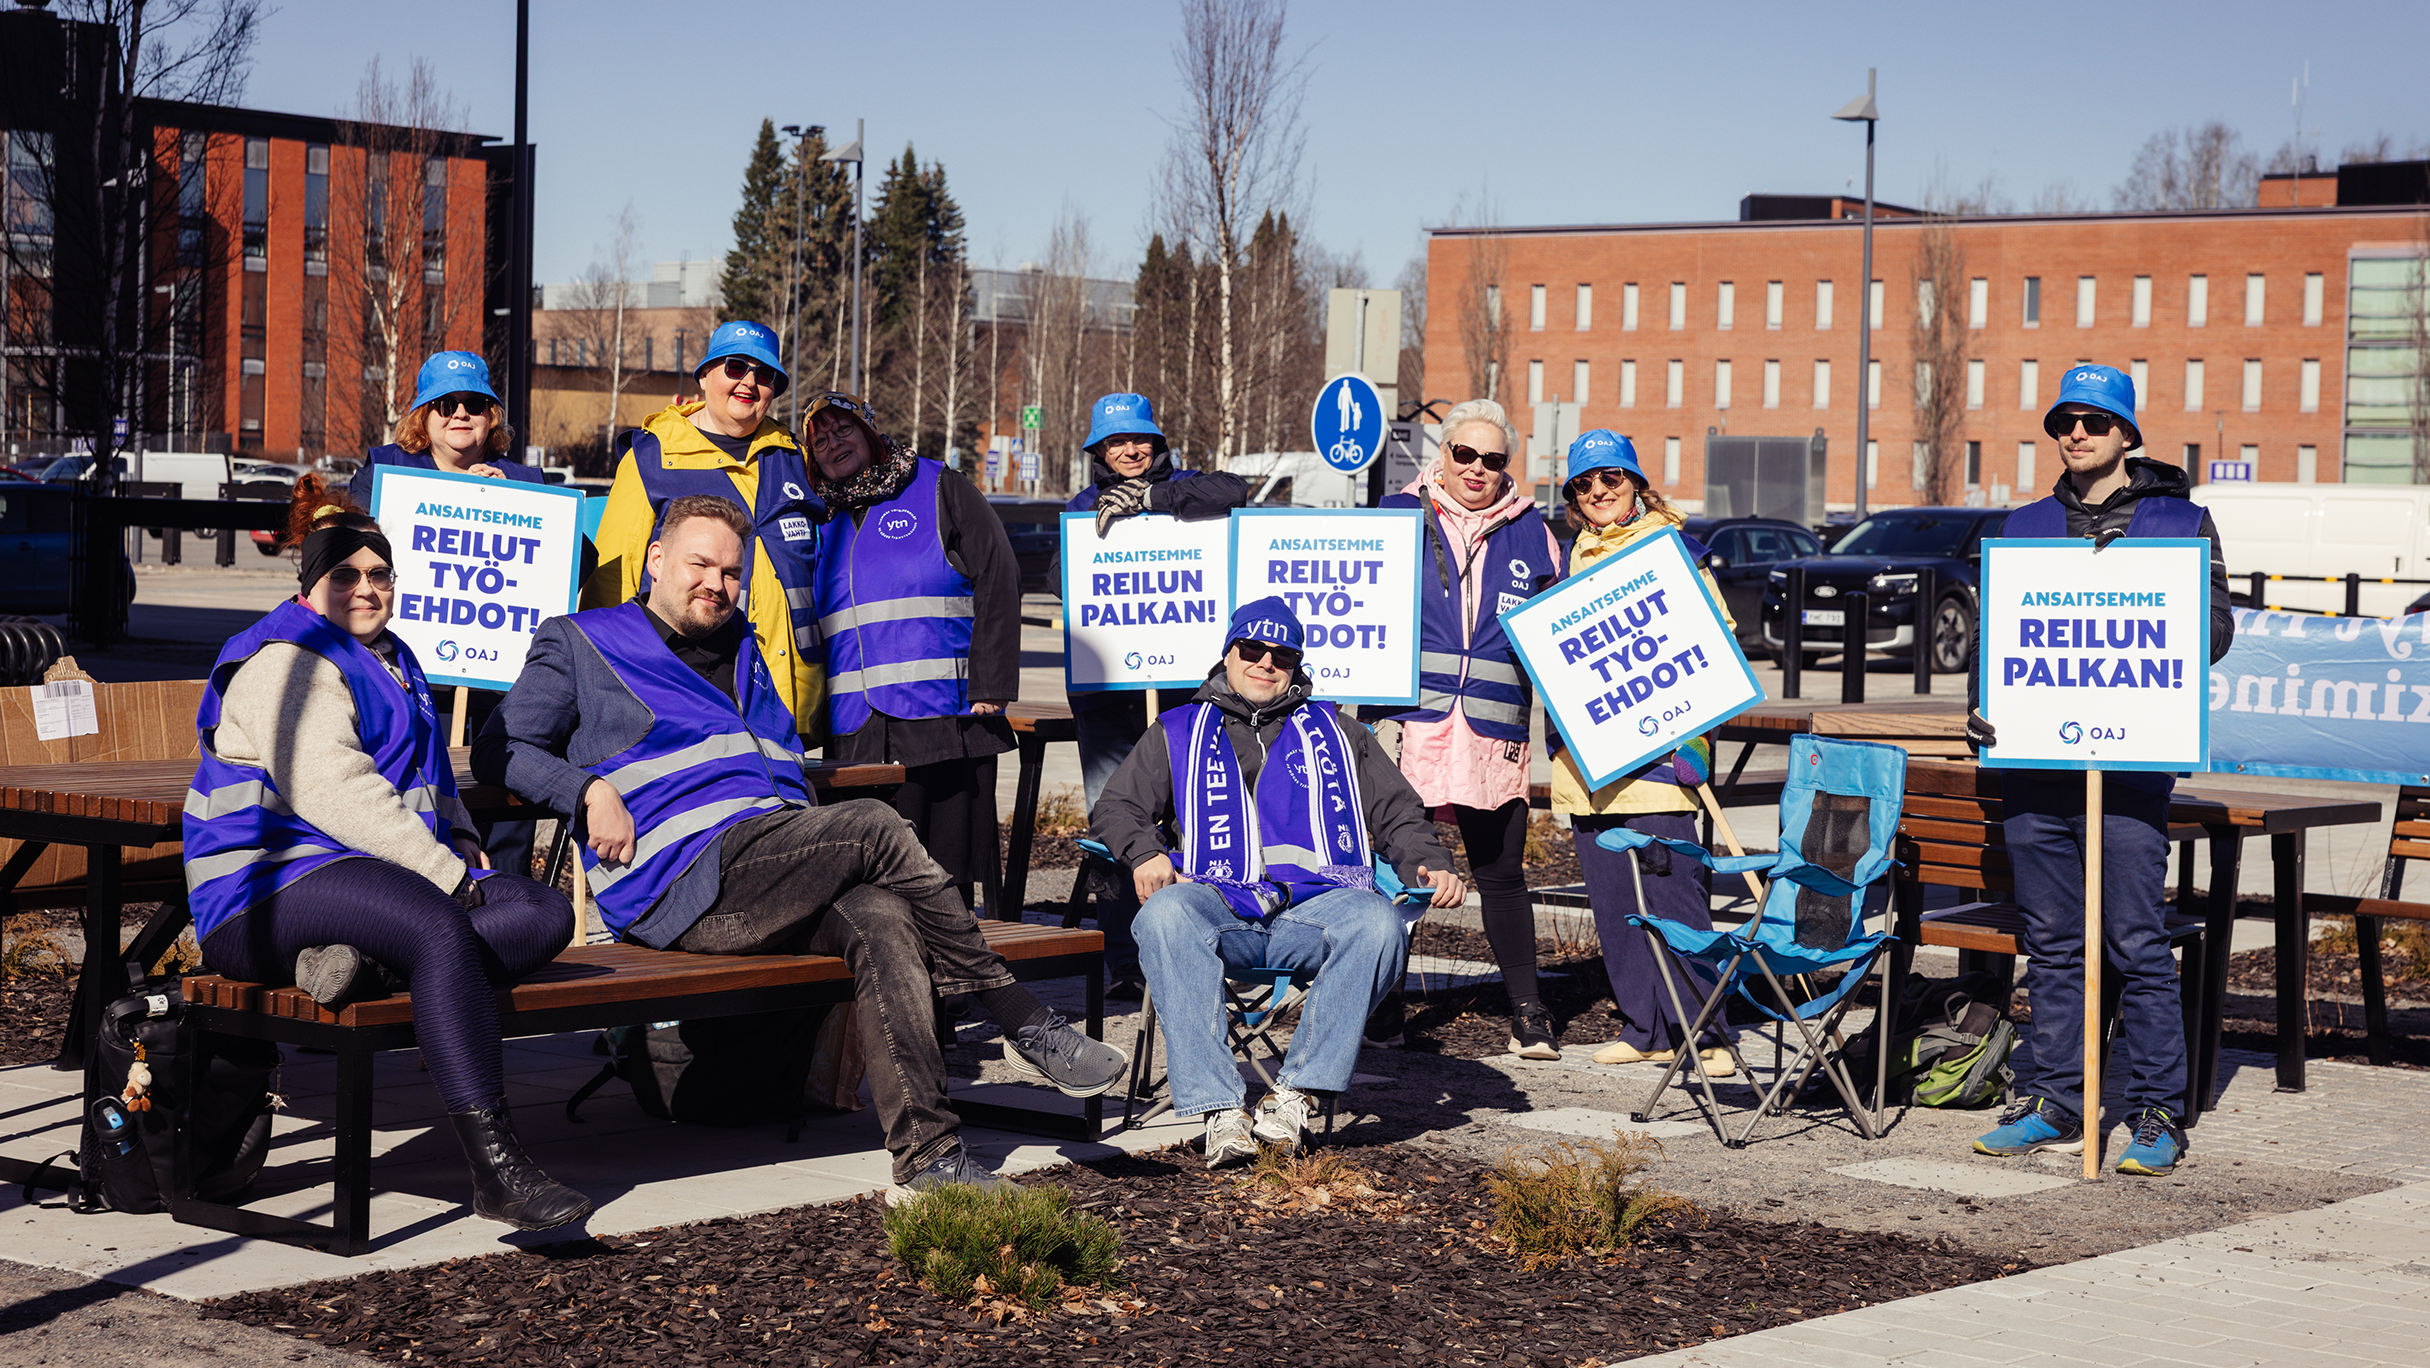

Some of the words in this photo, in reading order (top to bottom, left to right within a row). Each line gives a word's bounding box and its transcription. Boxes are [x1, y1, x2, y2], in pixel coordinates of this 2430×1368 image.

[749, 329, 765, 339] OAJ
[460, 361, 476, 370] OAJ
[2089, 373, 2107, 383] OAJ
[414, 502, 543, 530] ANSAITSEMME
[886, 518, 909, 531] ytn
[412, 524, 541, 565] REILUT
[1092, 548, 1202, 564] ANSAITSEMME
[1268, 538, 1384, 552] ANSAITSEMME
[429, 560, 518, 595] TYÖ-
[1092, 569, 1203, 597] REILUN
[1267, 559, 1384, 585] REILUT
[1511, 580, 1529, 591] OAJ
[1284, 585, 1364, 617] TYÖ-
[1550, 569, 1658, 636] ANSAITSEMME
[2020, 591, 2166, 607] ANSAITSEMME
[400, 593, 541, 635] EHDOT!
[1081, 599, 1216, 627] PALKAN!
[1246, 618, 1288, 642] ytn
[1301, 623, 1387, 650] DOT!
[1558, 588, 1669, 666] REILUT
[2019, 618, 2166, 649] REILUN
[465, 647, 498, 662] OAJ
[1147, 654, 1175, 666] OAJ
[1589, 628, 1669, 684] TYÖ-
[1320, 667, 1351, 679] OAJ
[1584, 643, 1709, 726] EHDOT!
[2003, 657, 2184, 689] PALKAN!
[1662, 700, 1692, 722] OAJ
[2090, 727, 2126, 741] OAJ
[1206, 757, 1229, 807] TEE
[1307, 727, 1347, 813] TYÖTÄ
[1208, 813, 1231, 850] EN
